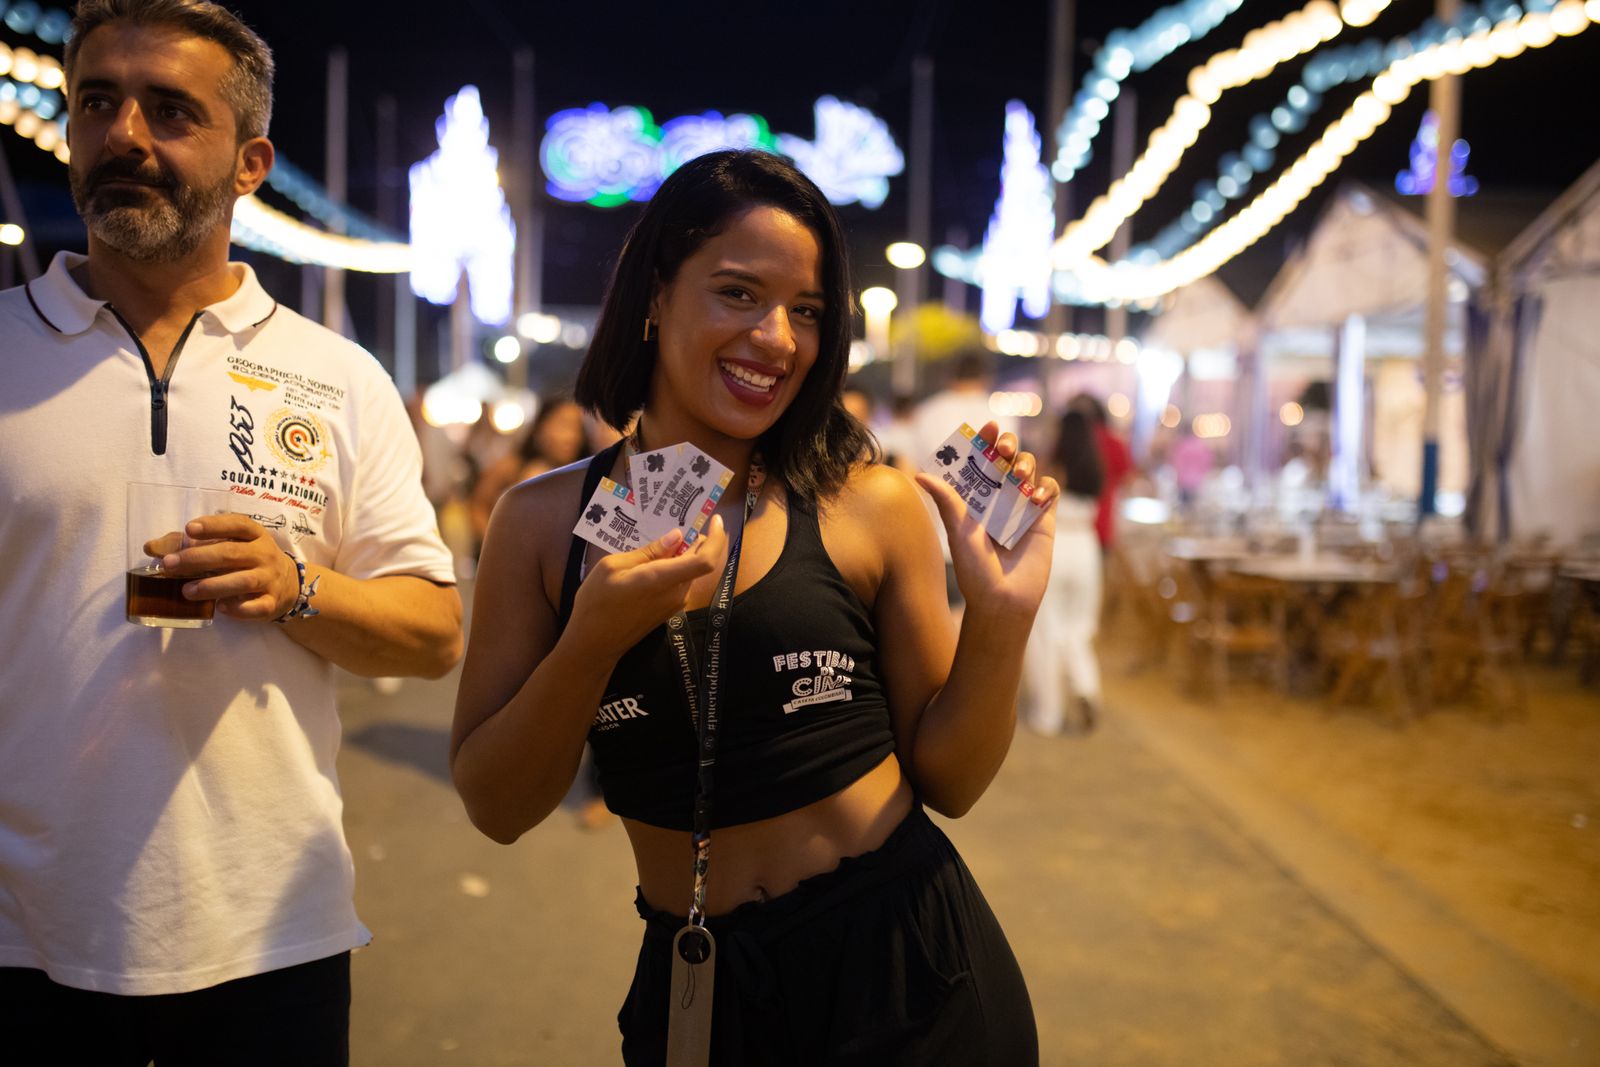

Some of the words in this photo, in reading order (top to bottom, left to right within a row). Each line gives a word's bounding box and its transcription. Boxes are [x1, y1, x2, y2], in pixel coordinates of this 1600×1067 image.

[227, 356, 304, 381] GEOGRAPHICAL
[307, 378, 345, 398] NORWAY
[229, 395, 254, 473] 1953
[221, 470, 275, 490] SQUADRA
[281, 482, 329, 507] NAZIONALE
[652, 467, 687, 517] FESTIBAR
[669, 480, 695, 518] CINE
[958, 465, 991, 498] CINE
[596, 528, 637, 552] STIBAR
[773, 650, 855, 673] FESTIBAR
[706, 631, 721, 731] #puertodeindias
[596, 698, 649, 723] ATER
